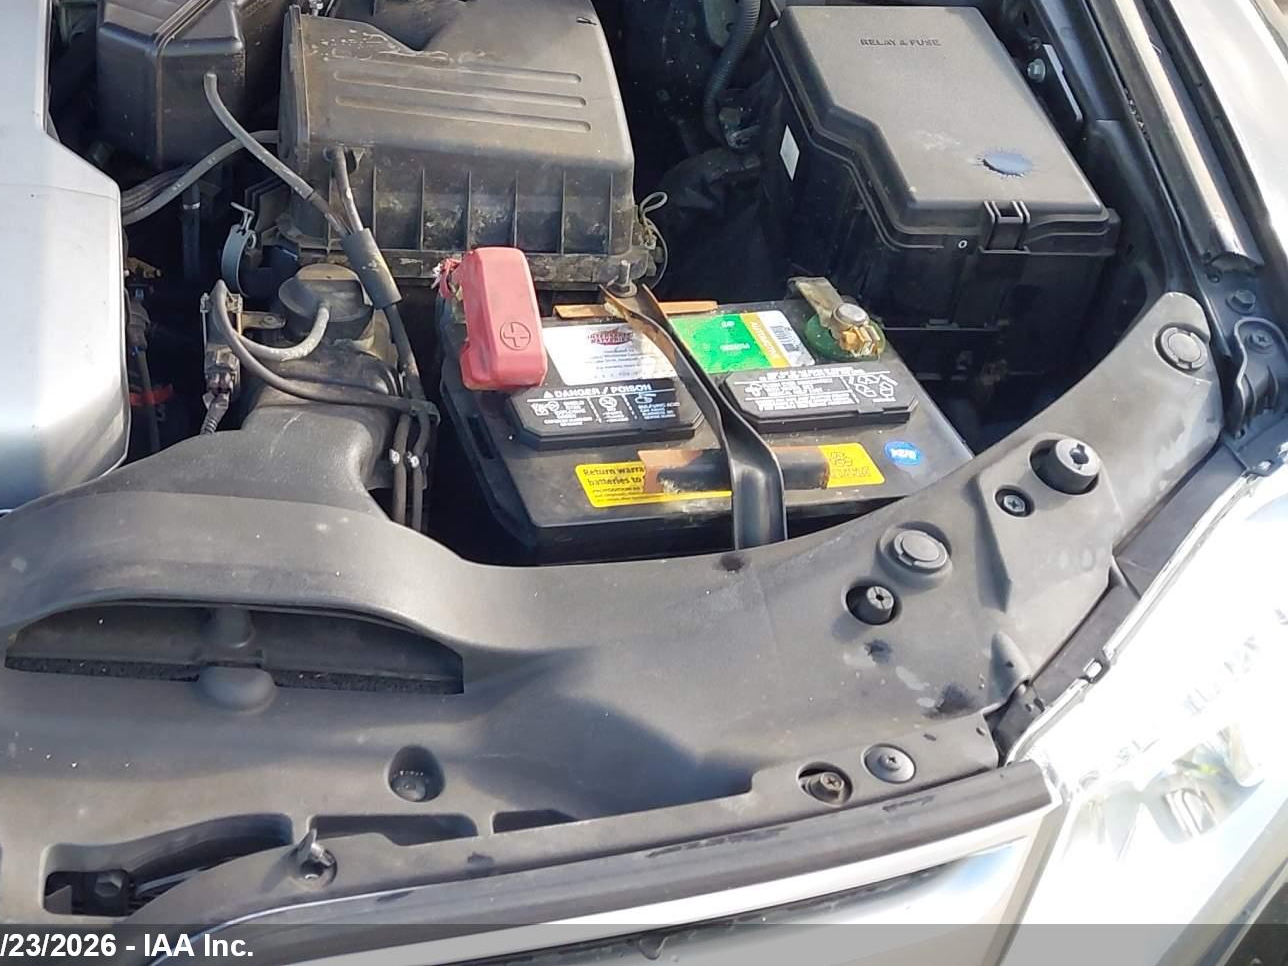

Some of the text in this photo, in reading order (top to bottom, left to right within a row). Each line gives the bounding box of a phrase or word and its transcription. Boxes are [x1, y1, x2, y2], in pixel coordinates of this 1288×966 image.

[858, 38, 896, 46] RELAY
[909, 38, 942, 46] FUSE
[554, 387, 601, 398] DANGER
[610, 383, 653, 394] POISON
[583, 466, 645, 475] Return warra
[588, 477, 630, 485] batteries
